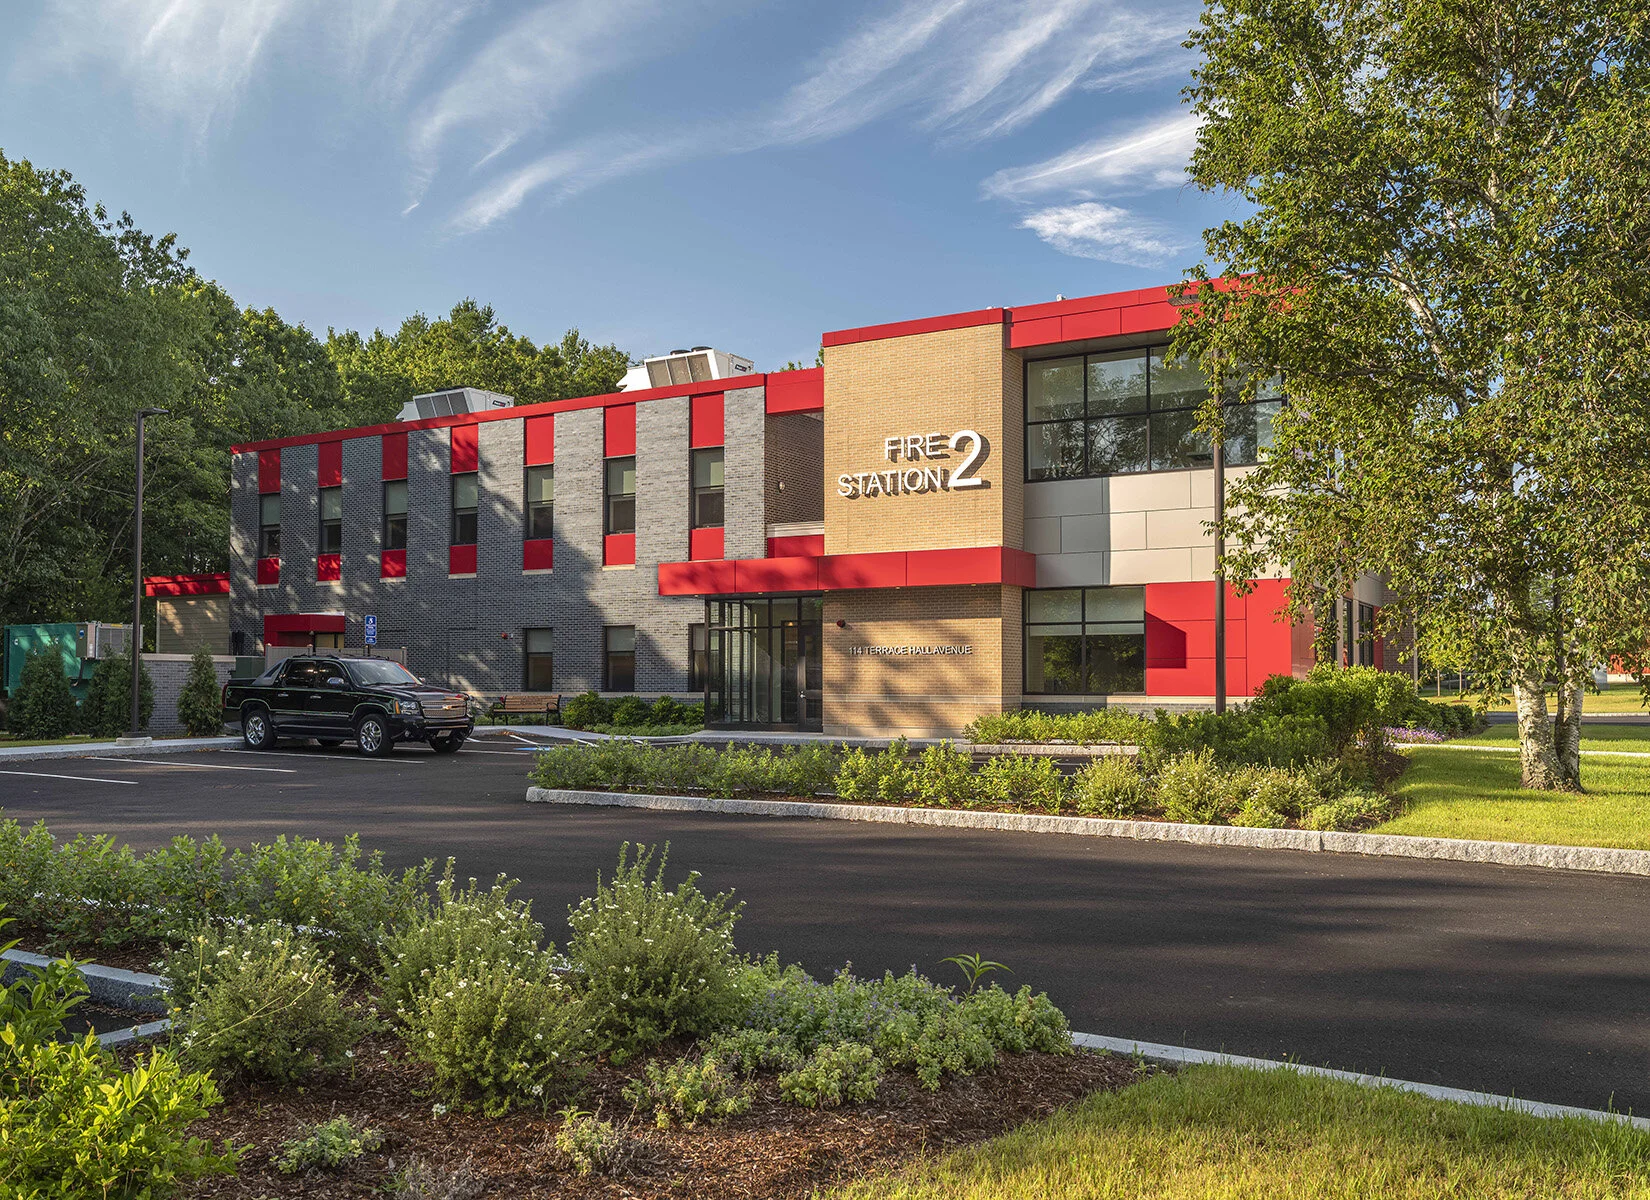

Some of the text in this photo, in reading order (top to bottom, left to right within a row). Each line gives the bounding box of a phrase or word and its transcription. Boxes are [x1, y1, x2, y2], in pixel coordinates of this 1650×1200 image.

[884, 432, 942, 460] FIRE
[947, 429, 983, 488] 2
[836, 465, 942, 497] STATION
[848, 645, 973, 655] 114 TERRACE HALL AVENUE
